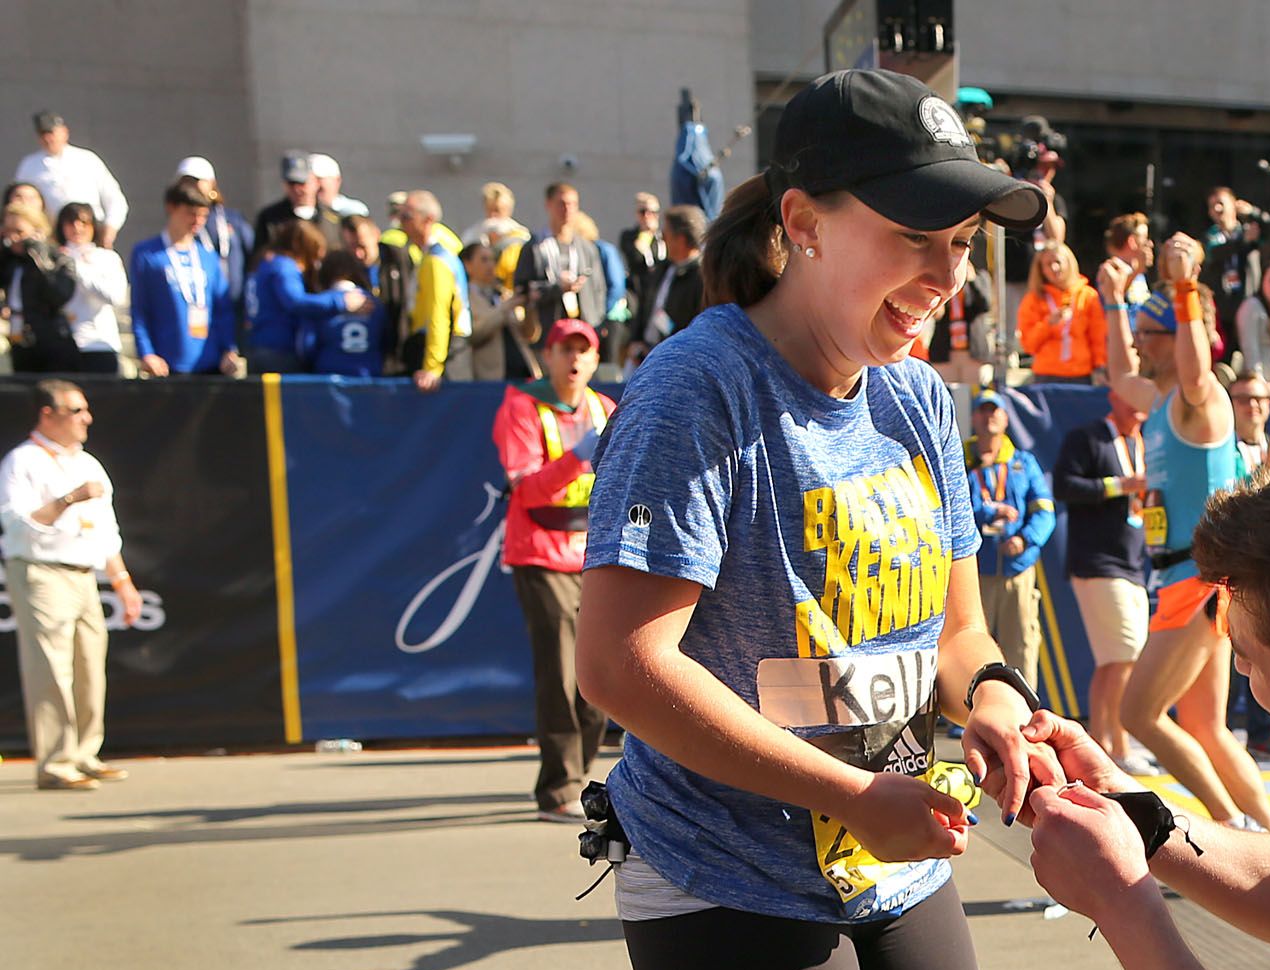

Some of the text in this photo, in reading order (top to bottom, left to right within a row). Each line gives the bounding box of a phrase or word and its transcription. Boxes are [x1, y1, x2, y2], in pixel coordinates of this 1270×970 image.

[803, 455, 942, 552] BOSTON
[819, 518, 943, 603] KEEPS
[818, 650, 938, 725] Kell
[883, 753, 928, 776] adida
